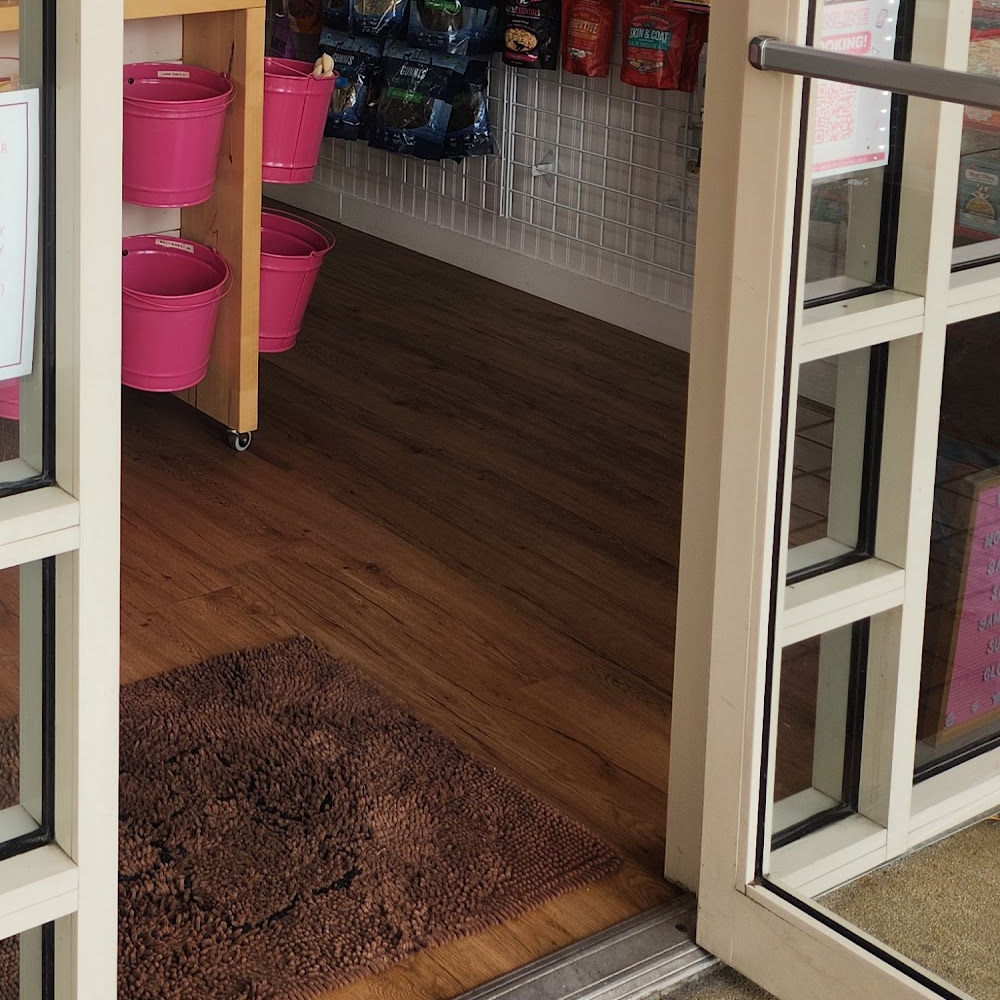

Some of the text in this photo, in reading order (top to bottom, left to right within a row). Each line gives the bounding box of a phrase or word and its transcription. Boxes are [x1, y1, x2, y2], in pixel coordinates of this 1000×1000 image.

[824, 8, 870, 30] NLINE
[629, 28, 670, 43] SKIN & COAT
